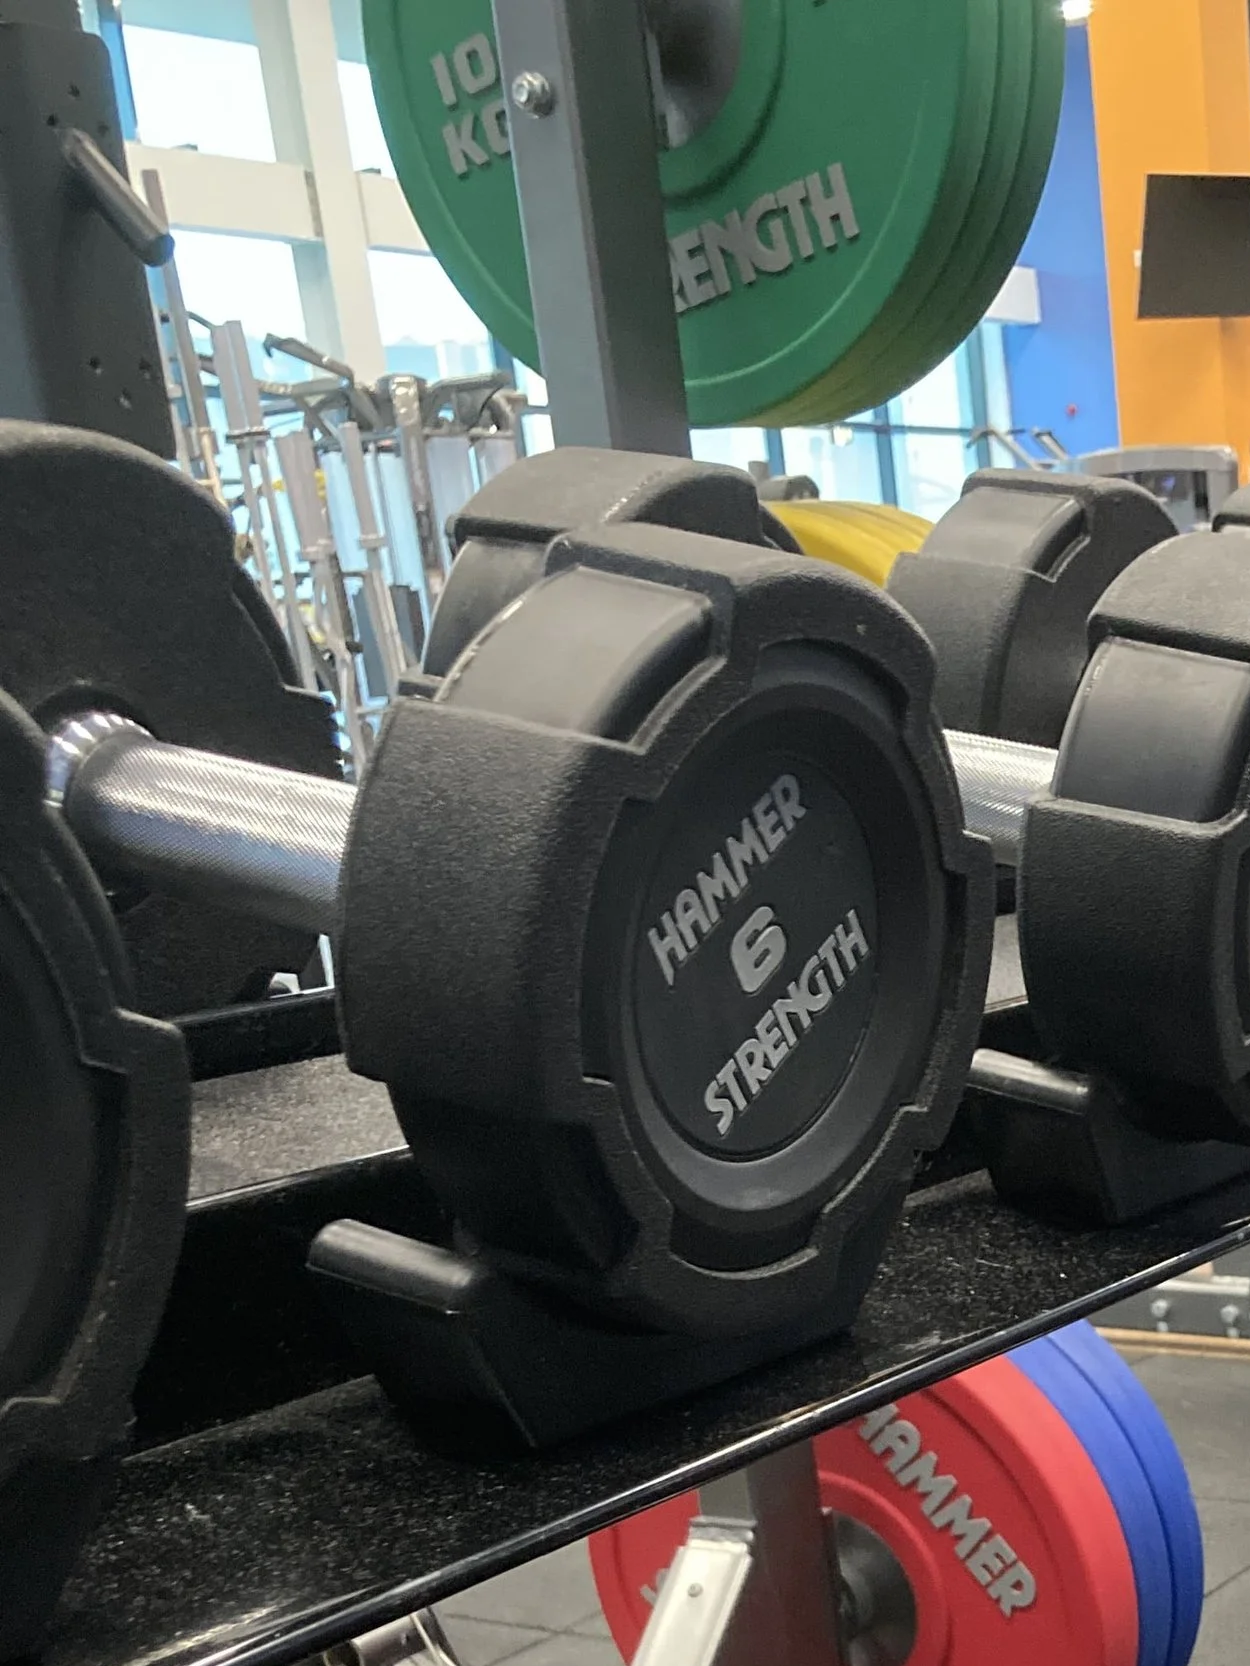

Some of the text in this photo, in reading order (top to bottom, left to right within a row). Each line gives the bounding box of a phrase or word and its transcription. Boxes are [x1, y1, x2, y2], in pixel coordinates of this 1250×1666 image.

[430, 33, 497, 106] 10
[669, 161, 861, 315] ENGTH
[648, 774, 808, 987] HAMMER
[730, 906, 788, 994] 6
[704, 909, 870, 1137] STRENGTH
